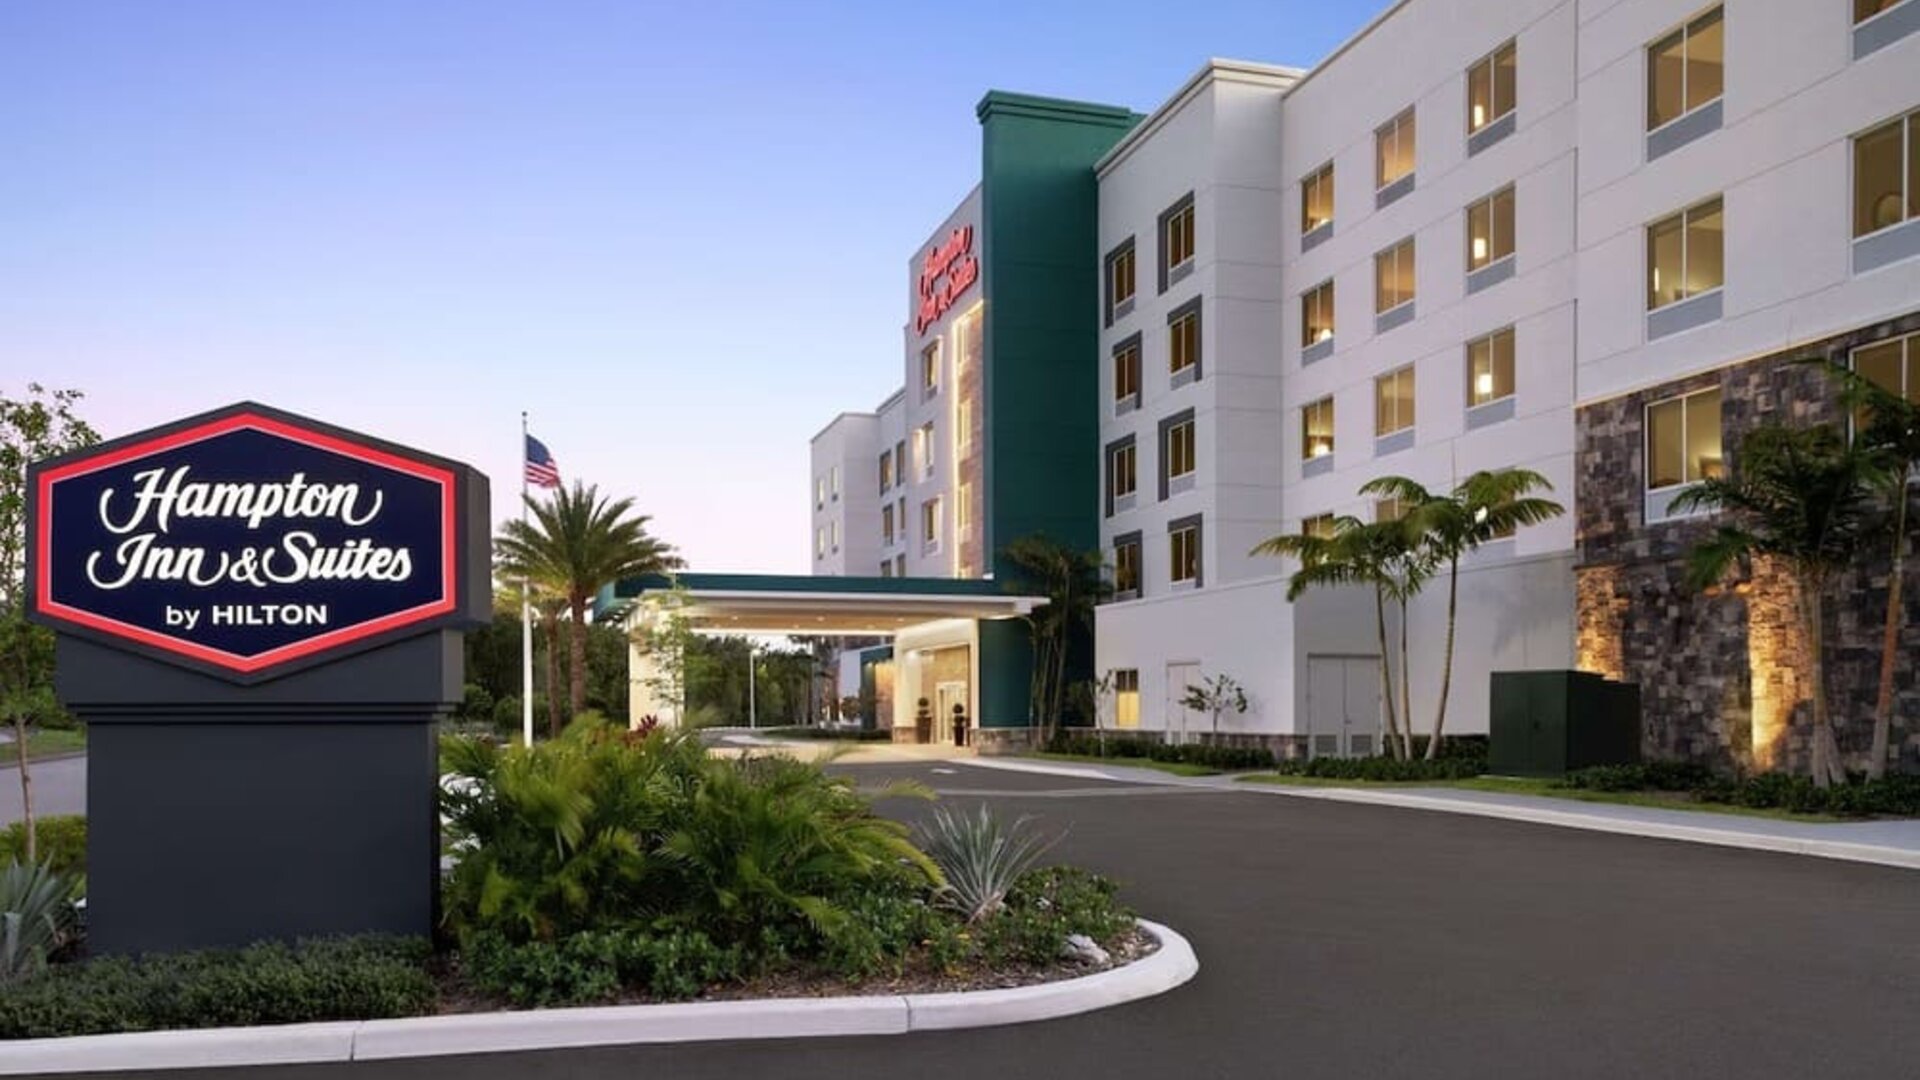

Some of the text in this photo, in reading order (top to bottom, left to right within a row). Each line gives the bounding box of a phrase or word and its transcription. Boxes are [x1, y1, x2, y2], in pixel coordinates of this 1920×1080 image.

[917, 224, 973, 299] Hampton
[99, 465, 383, 534] Hampton
[86, 530, 412, 590] Inn & Suites
[166, 604, 327, 630] by HILTON
